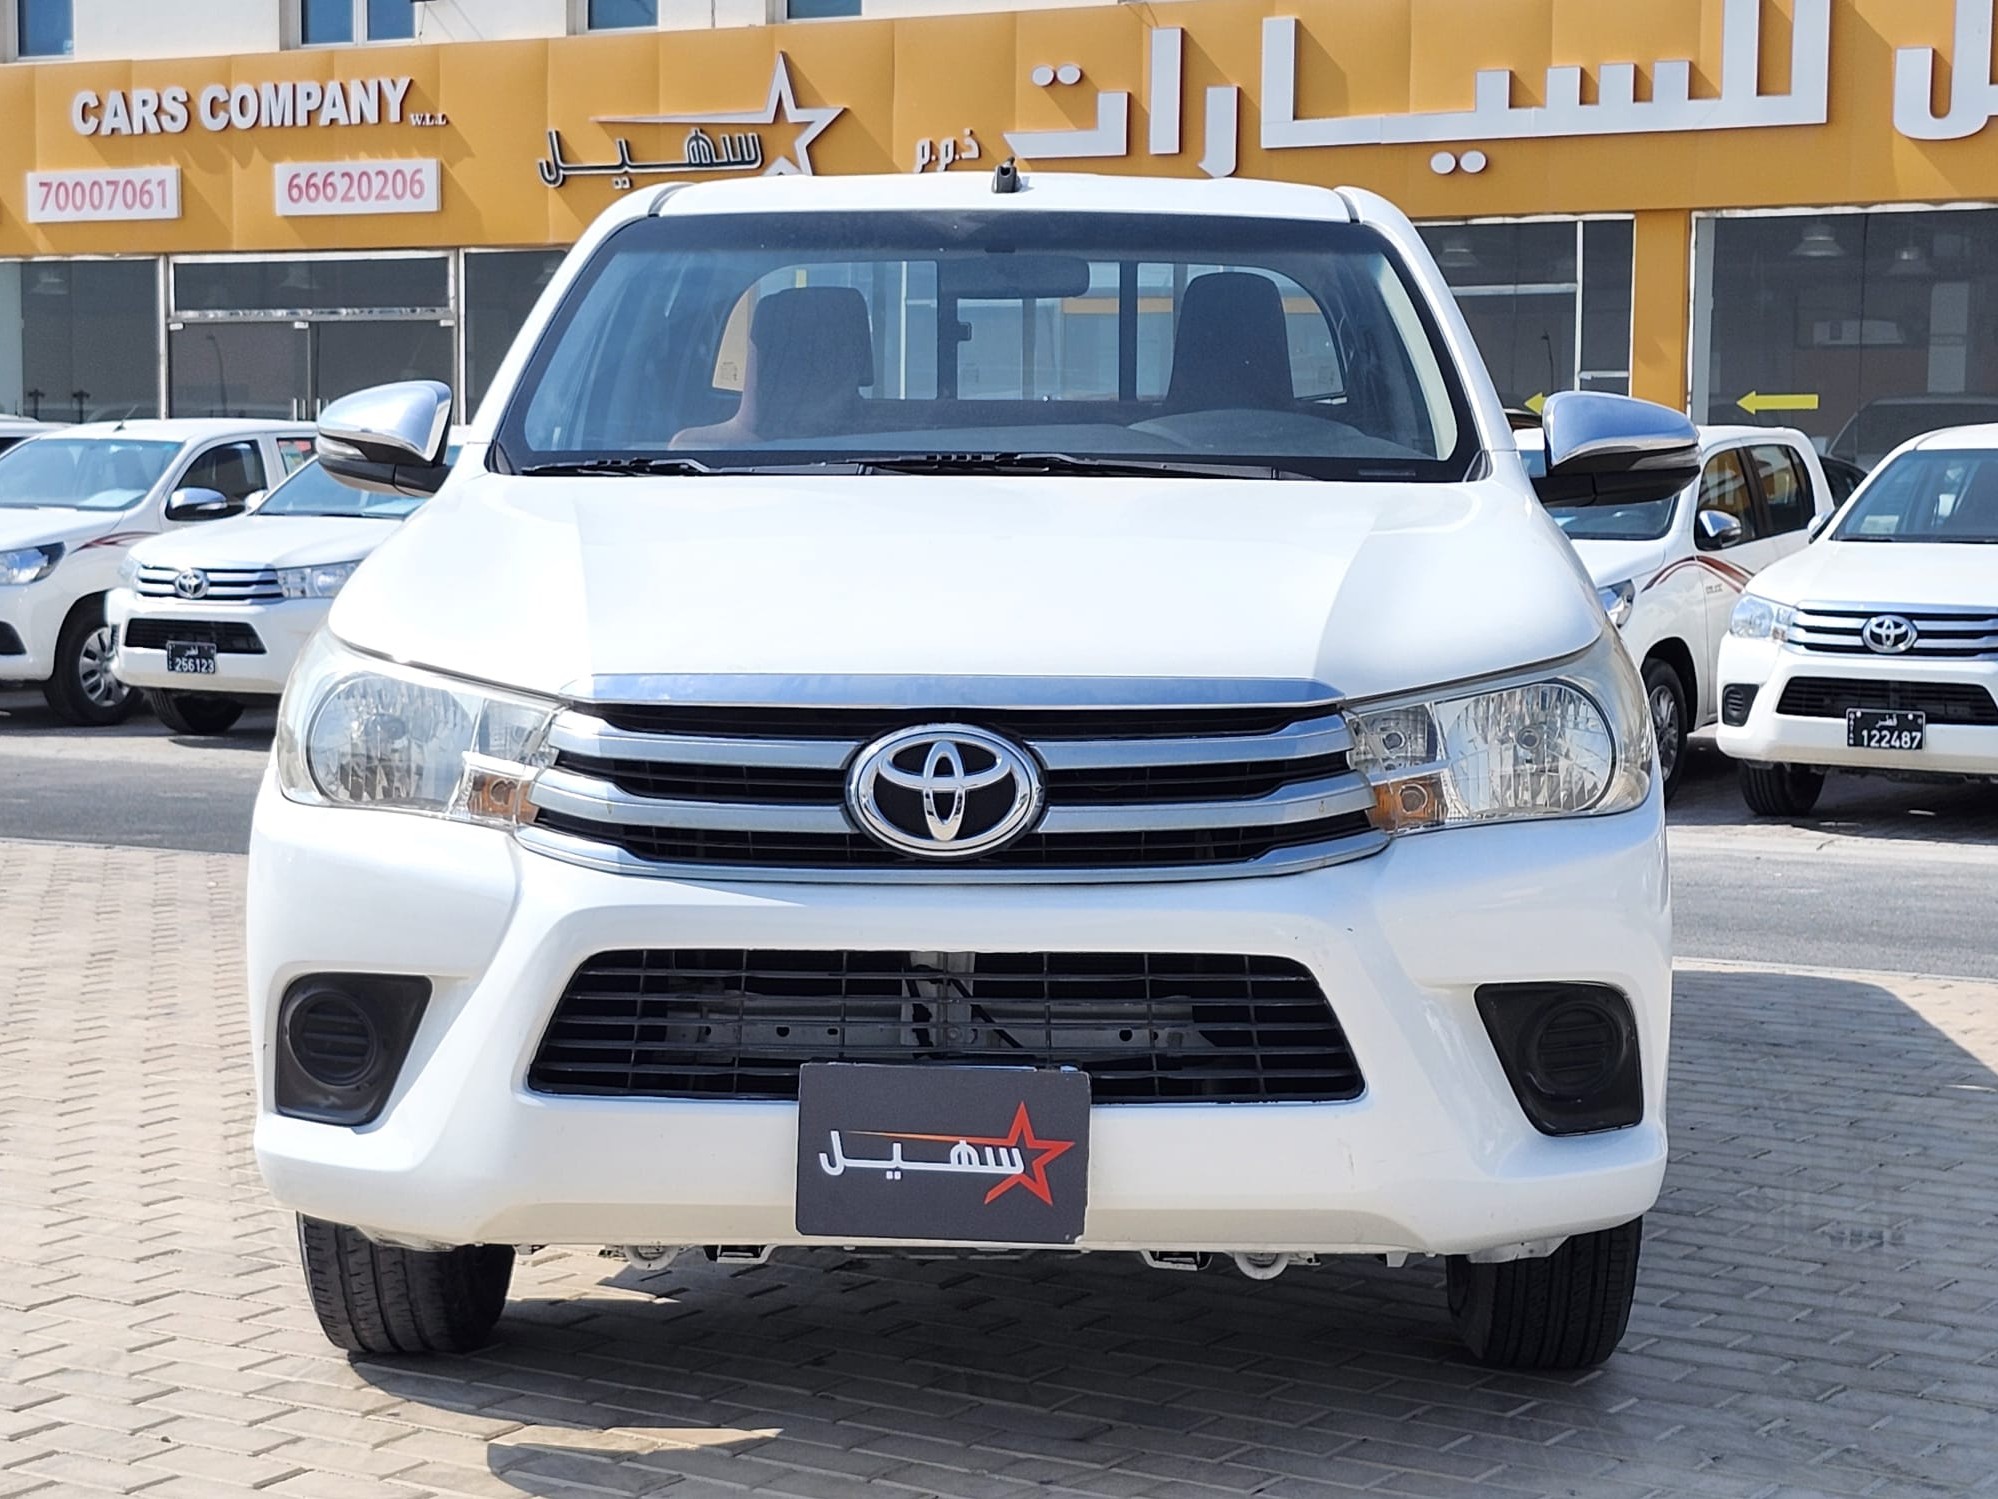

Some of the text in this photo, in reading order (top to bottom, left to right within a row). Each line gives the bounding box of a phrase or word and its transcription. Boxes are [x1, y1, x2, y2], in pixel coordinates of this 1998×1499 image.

[71, 86, 190, 137] CARS
[199, 77, 412, 132] COMPANY
[537, 127, 764, 190] سهيل
[38, 178, 168, 213] 70007061
[287, 167, 426, 205] 66620206
[174, 656, 215, 673] 256123
[1875, 713, 1898, 728] قطر
[1861, 729, 1922, 749] 122487
[818, 1130, 1025, 1180] سهيل
